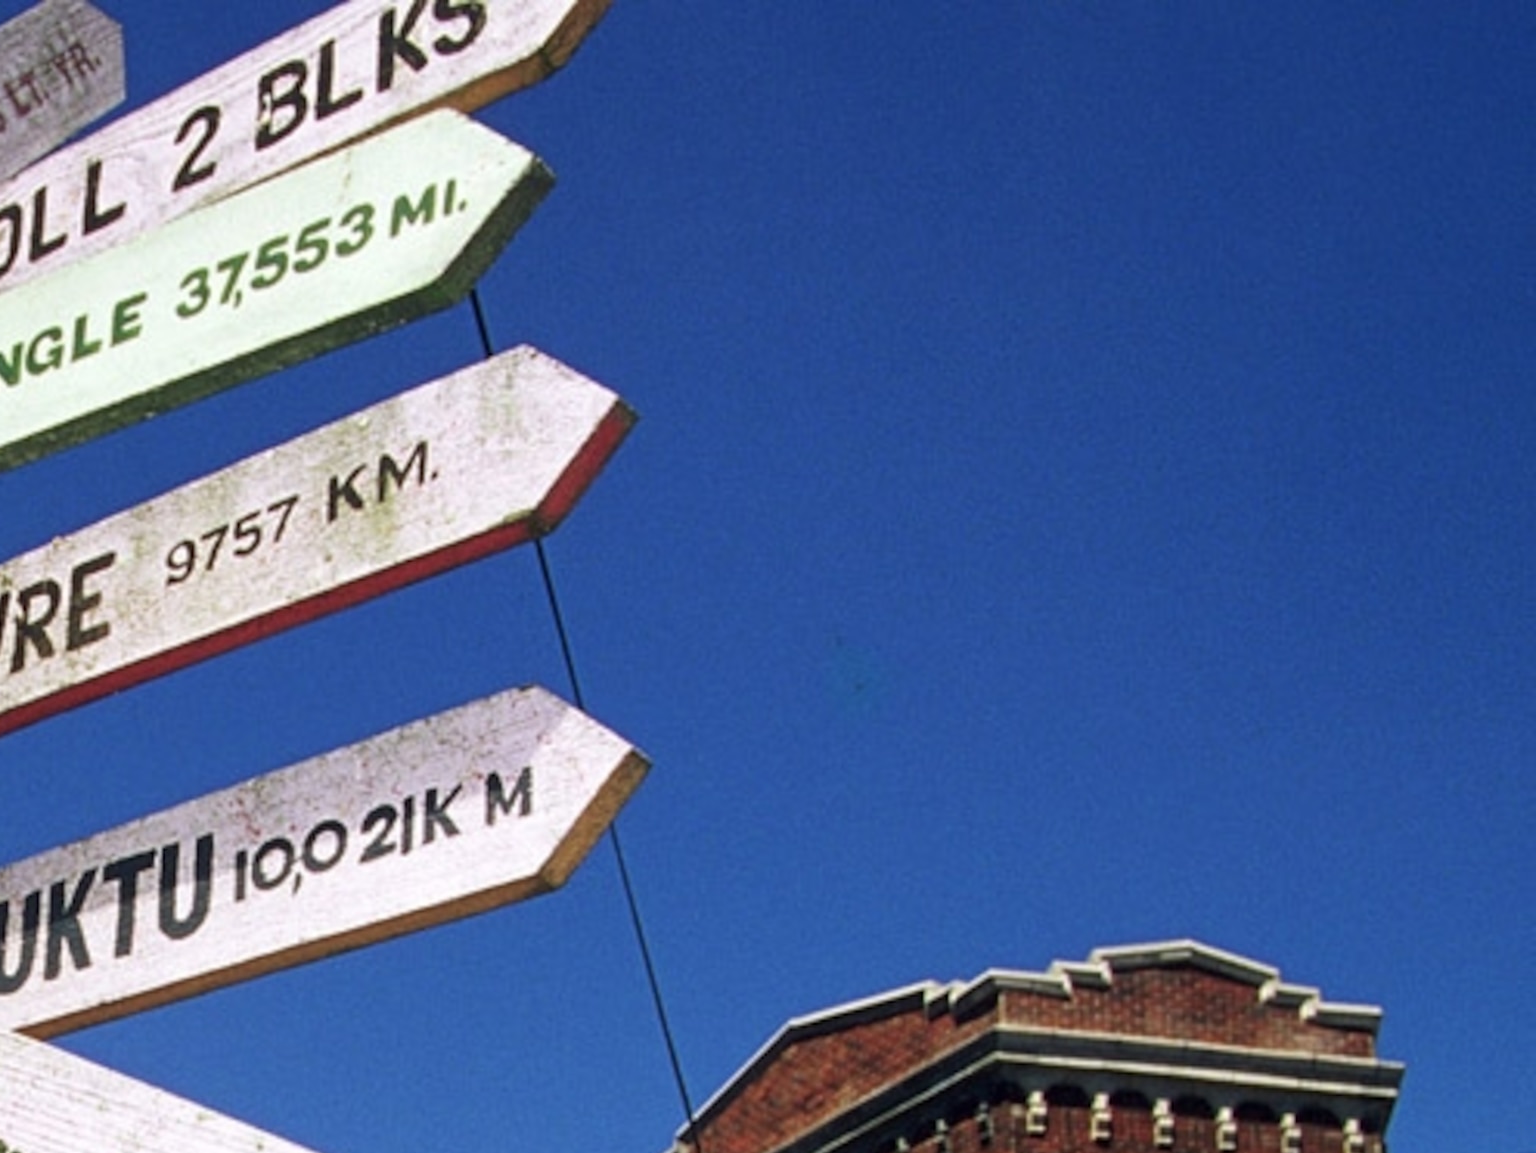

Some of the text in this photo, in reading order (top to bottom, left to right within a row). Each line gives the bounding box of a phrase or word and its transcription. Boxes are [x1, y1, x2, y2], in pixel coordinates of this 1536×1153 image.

[172, 105, 221, 193] 2
[255, 0, 488, 151] BLKS
[175, 203, 374, 322] 37,553
[389, 179, 467, 241] MI.
[165, 496, 299, 587] 9757
[326, 440, 439, 523] KM.
